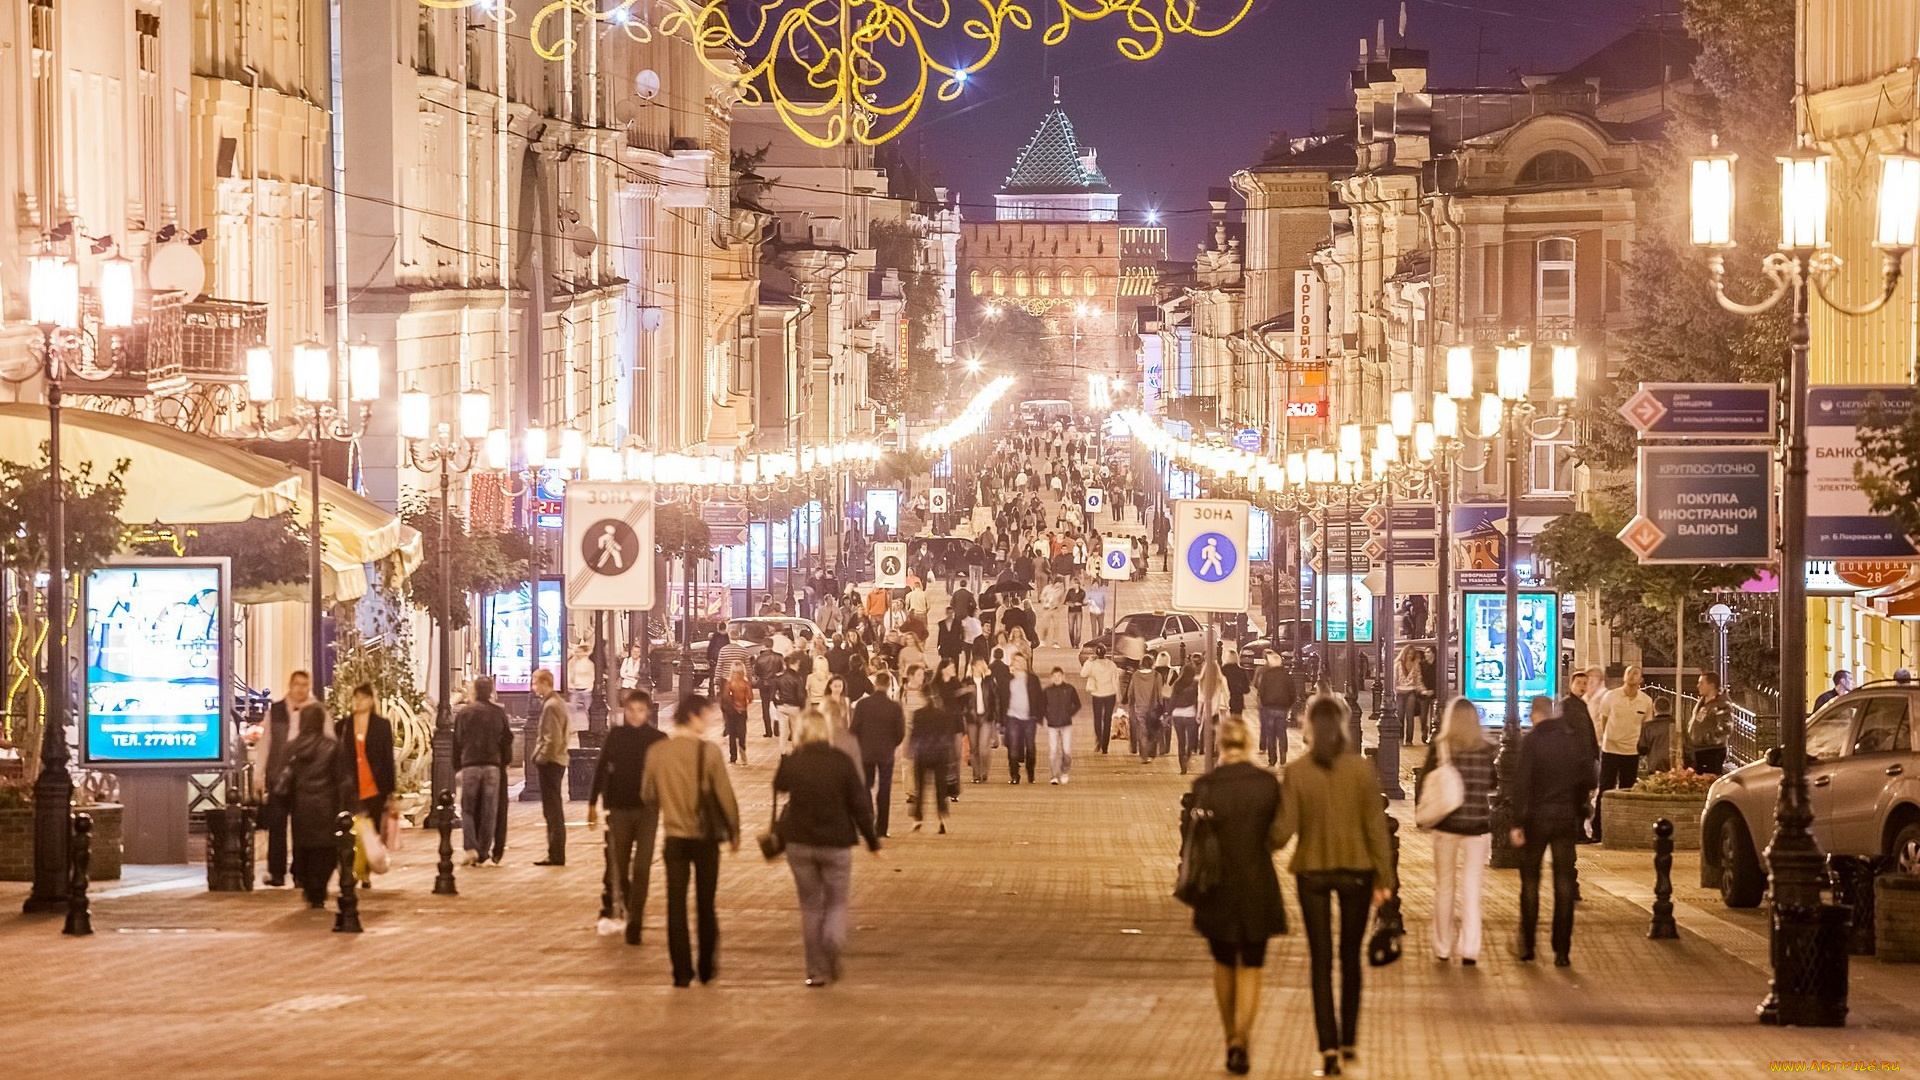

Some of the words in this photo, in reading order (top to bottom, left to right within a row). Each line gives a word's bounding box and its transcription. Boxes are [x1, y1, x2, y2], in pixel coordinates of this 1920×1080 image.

[1299, 273, 1311, 359] ТОРГОВЫЙ
[1816, 447, 1868, 458] БАНКО
[1659, 464, 1756, 474] КРУГЛОСУТОЧНО
[587, 490, 633, 505] ЗОНА
[1677, 493, 1739, 505] ПОКУПКА
[1193, 507, 1233, 520] ЗОНА
[1658, 507, 1757, 520] ИНОСТРАННОЙ
[1677, 524, 1738, 535] ВАЛЮТЫ
[1840, 562, 1908, 571] ПОКРОВКА
[1867, 572, 1882, 583] 28
[111, 734, 141, 746] ТЕЛ.
